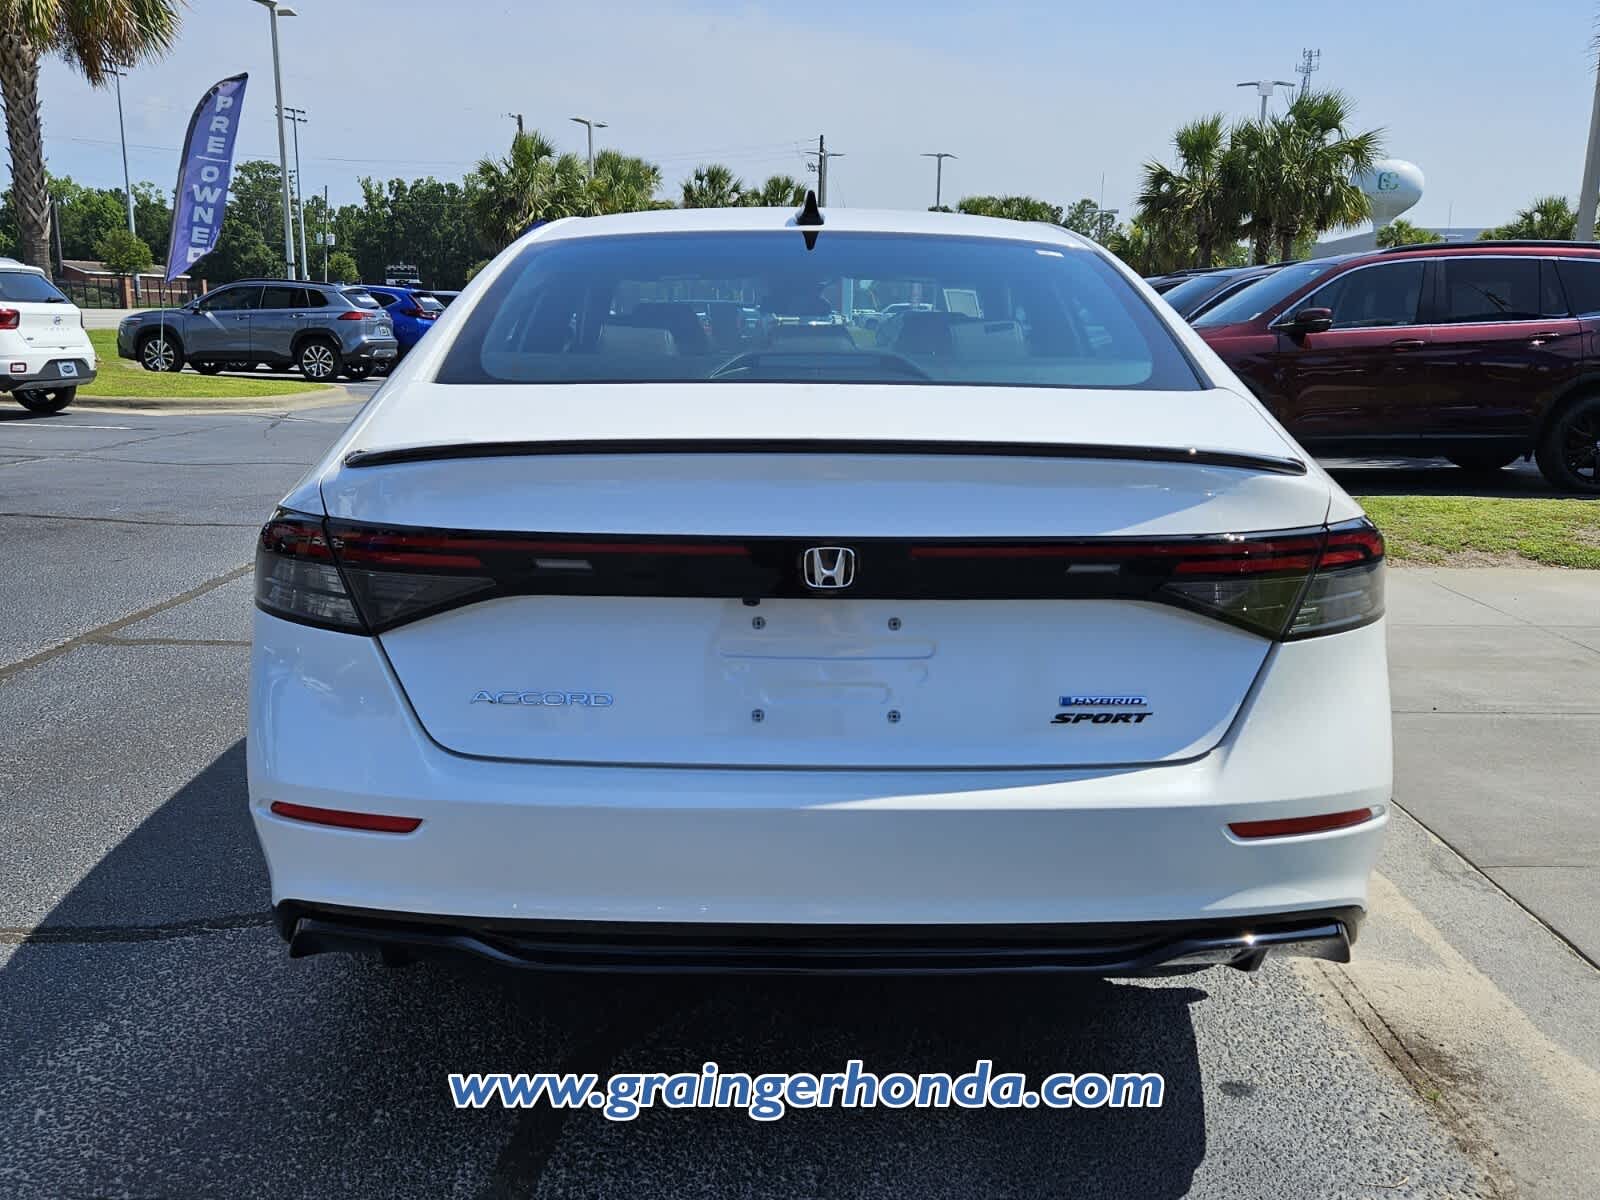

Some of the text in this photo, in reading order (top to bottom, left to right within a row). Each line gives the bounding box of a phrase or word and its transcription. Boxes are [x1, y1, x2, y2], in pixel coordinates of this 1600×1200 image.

[470, 690, 614, 706] ACCORD
[1073, 696, 1144, 706] HYBRID
[1050, 712, 1153, 724] SPORT
